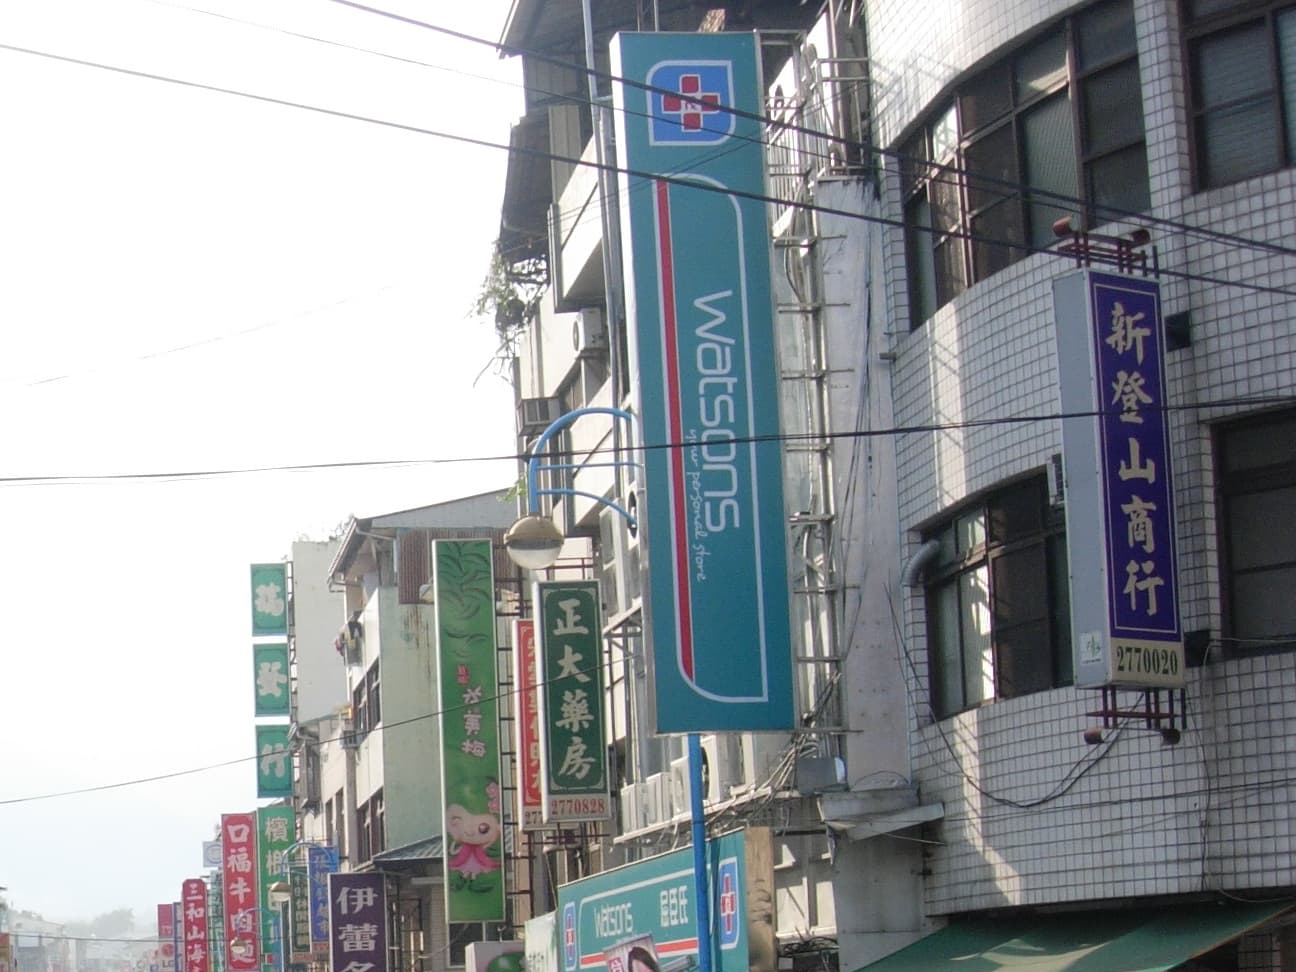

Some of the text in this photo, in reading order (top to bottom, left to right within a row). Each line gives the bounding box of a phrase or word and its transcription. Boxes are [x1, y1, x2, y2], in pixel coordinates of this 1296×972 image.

[1104, 301, 1166, 617] 新登山商行
[553, 598, 597, 780] 正大藥房
[1115, 645, 1180, 677] 2770020
